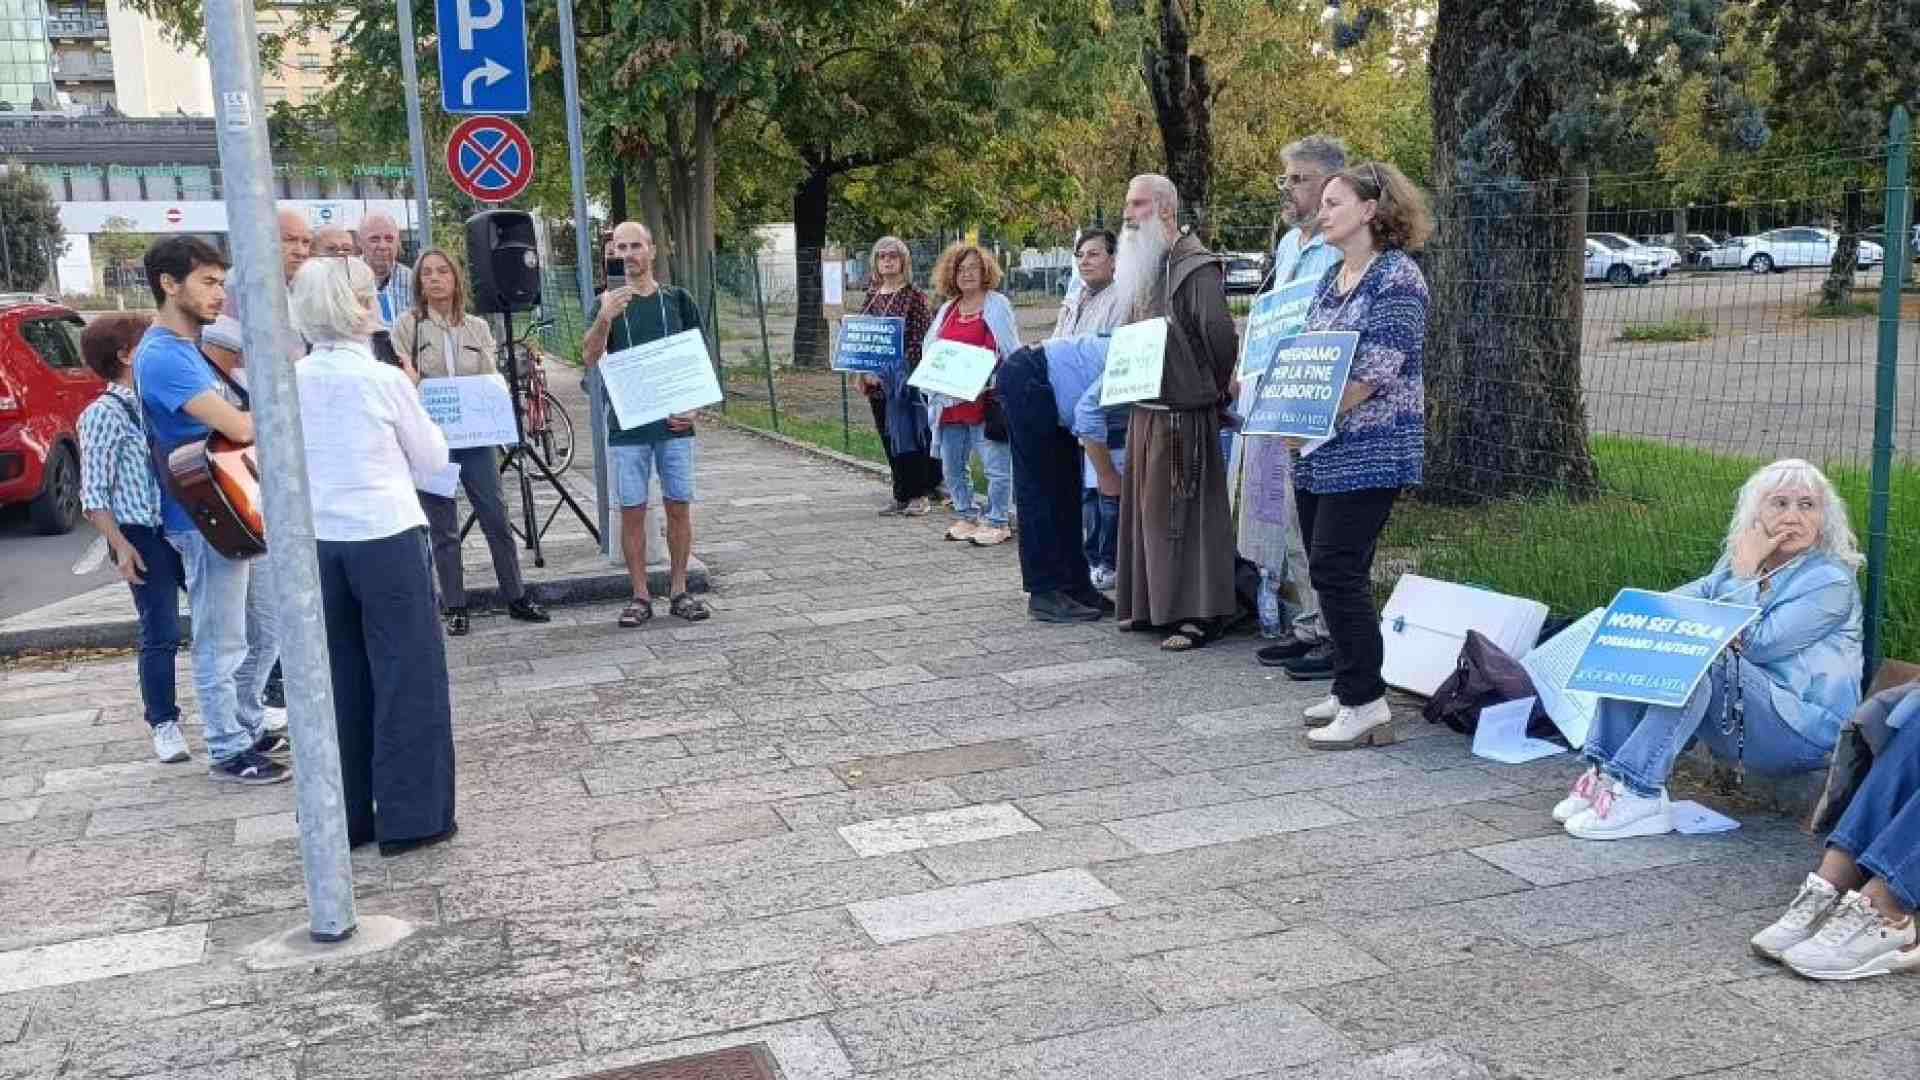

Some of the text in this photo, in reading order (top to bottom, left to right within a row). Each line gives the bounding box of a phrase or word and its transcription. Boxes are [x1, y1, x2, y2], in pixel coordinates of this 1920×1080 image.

[456, 0, 503, 49] P
[1289, 365, 1303, 380] LA
[1304, 365, 1334, 381] FINE
[1608, 612, 1725, 639] NON SEI SOLA
